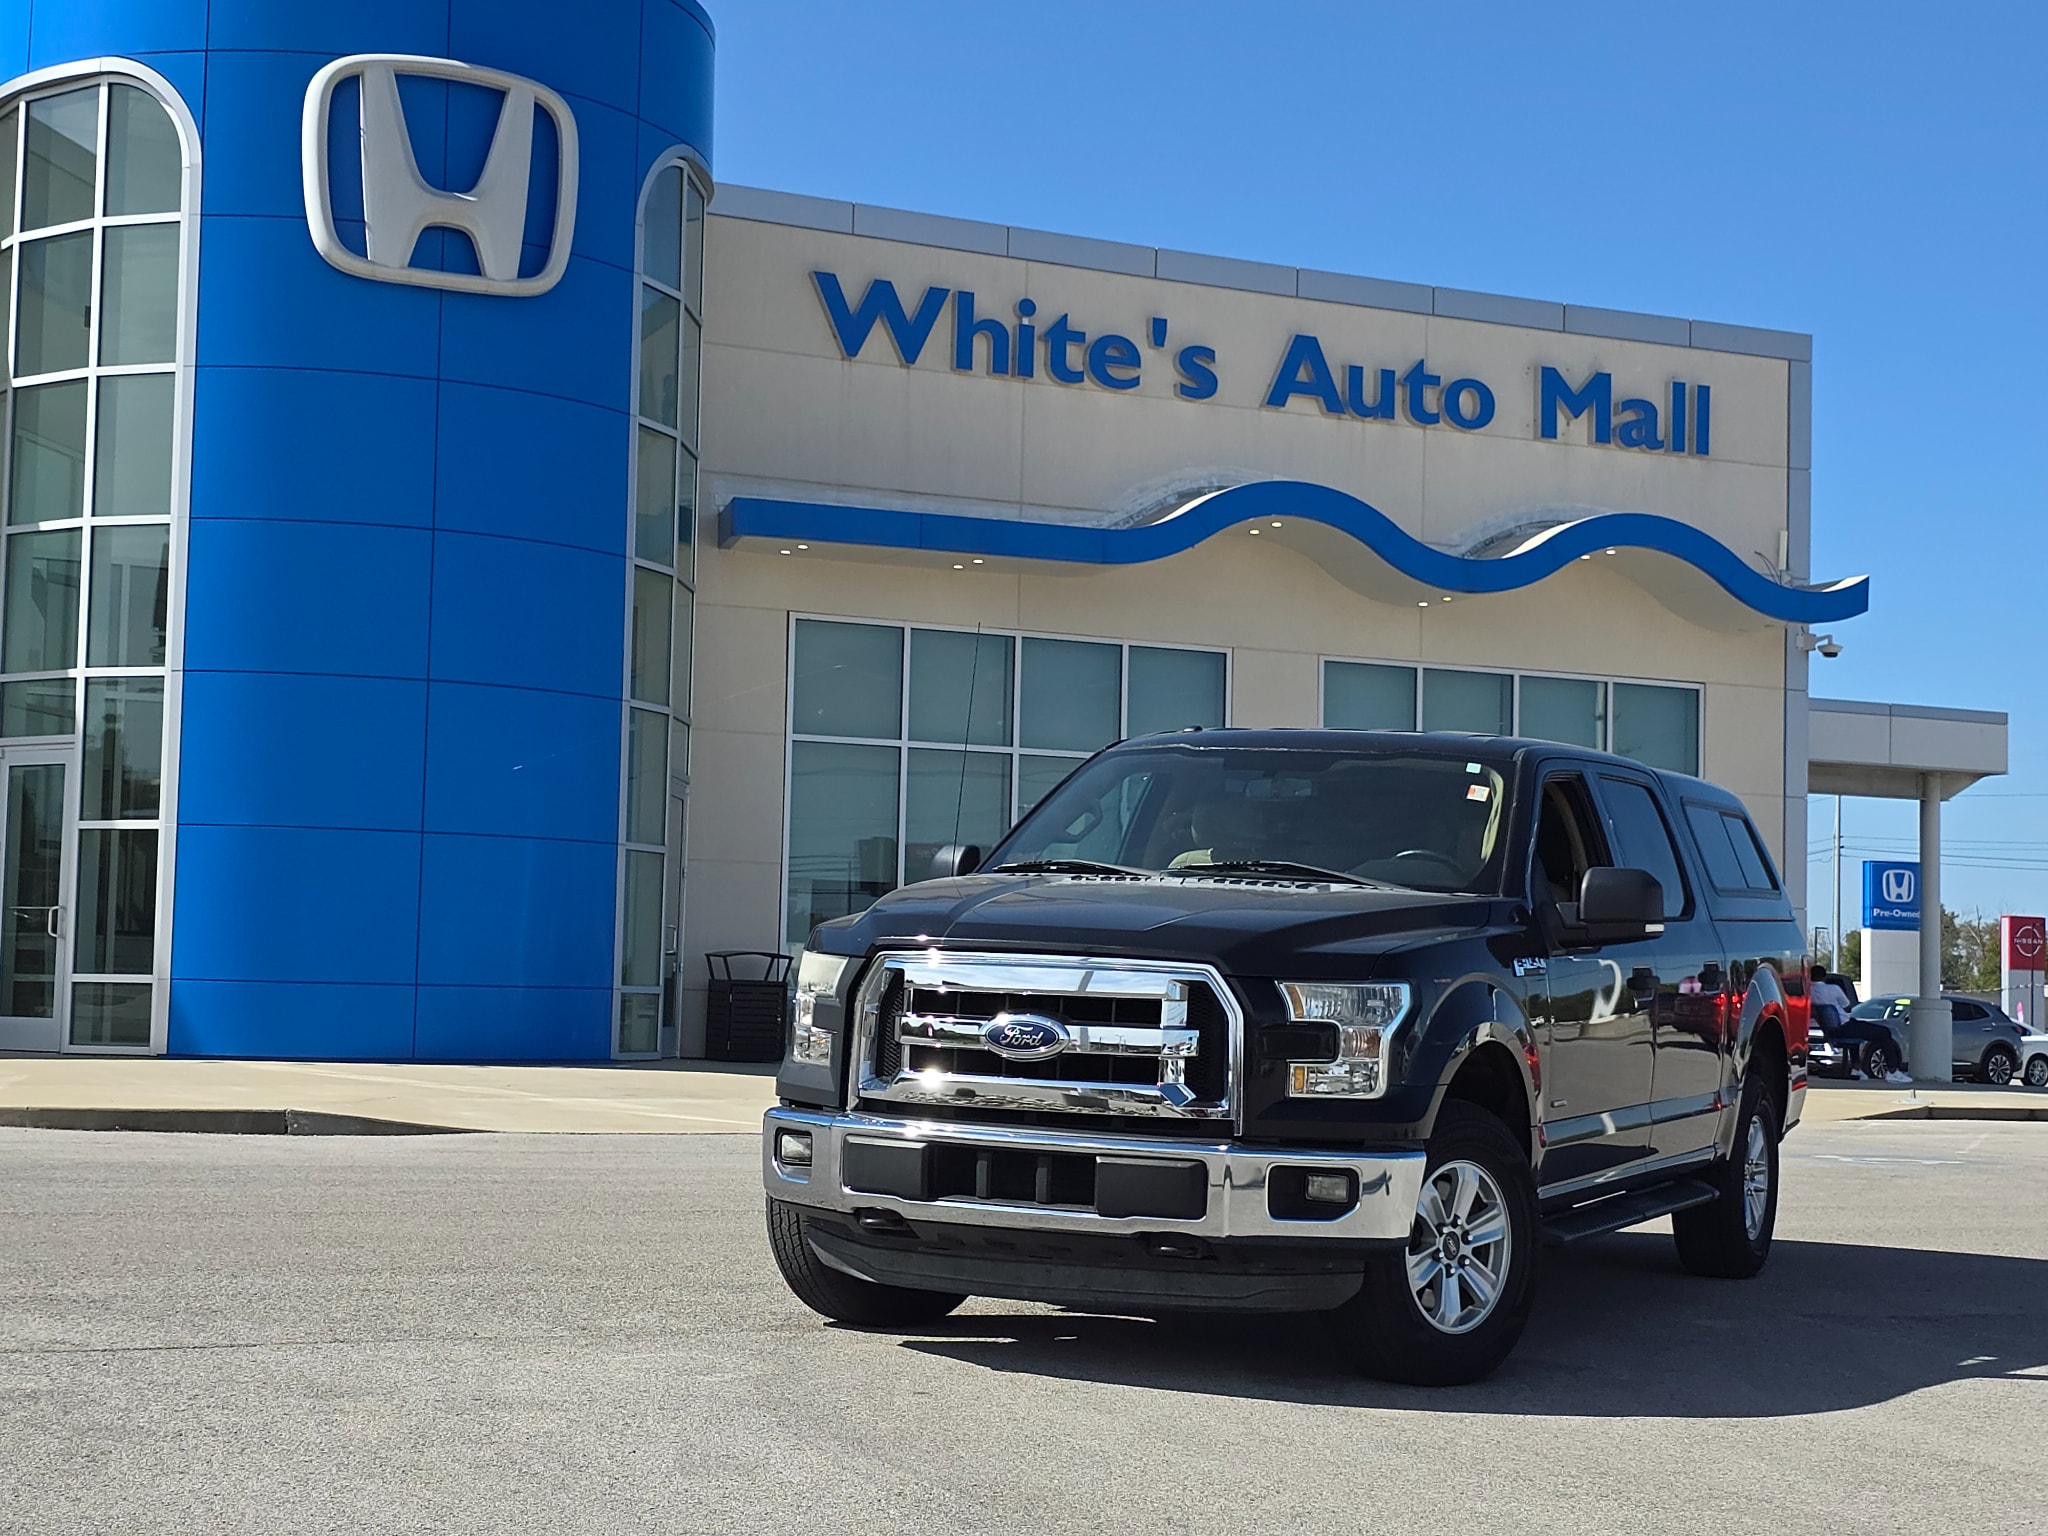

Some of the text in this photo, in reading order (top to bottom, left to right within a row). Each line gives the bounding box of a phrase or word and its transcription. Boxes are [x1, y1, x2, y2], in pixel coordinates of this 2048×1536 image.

[814, 271, 1712, 455] White's Auto Mall
[1000, 1024, 1044, 1046] Ford
